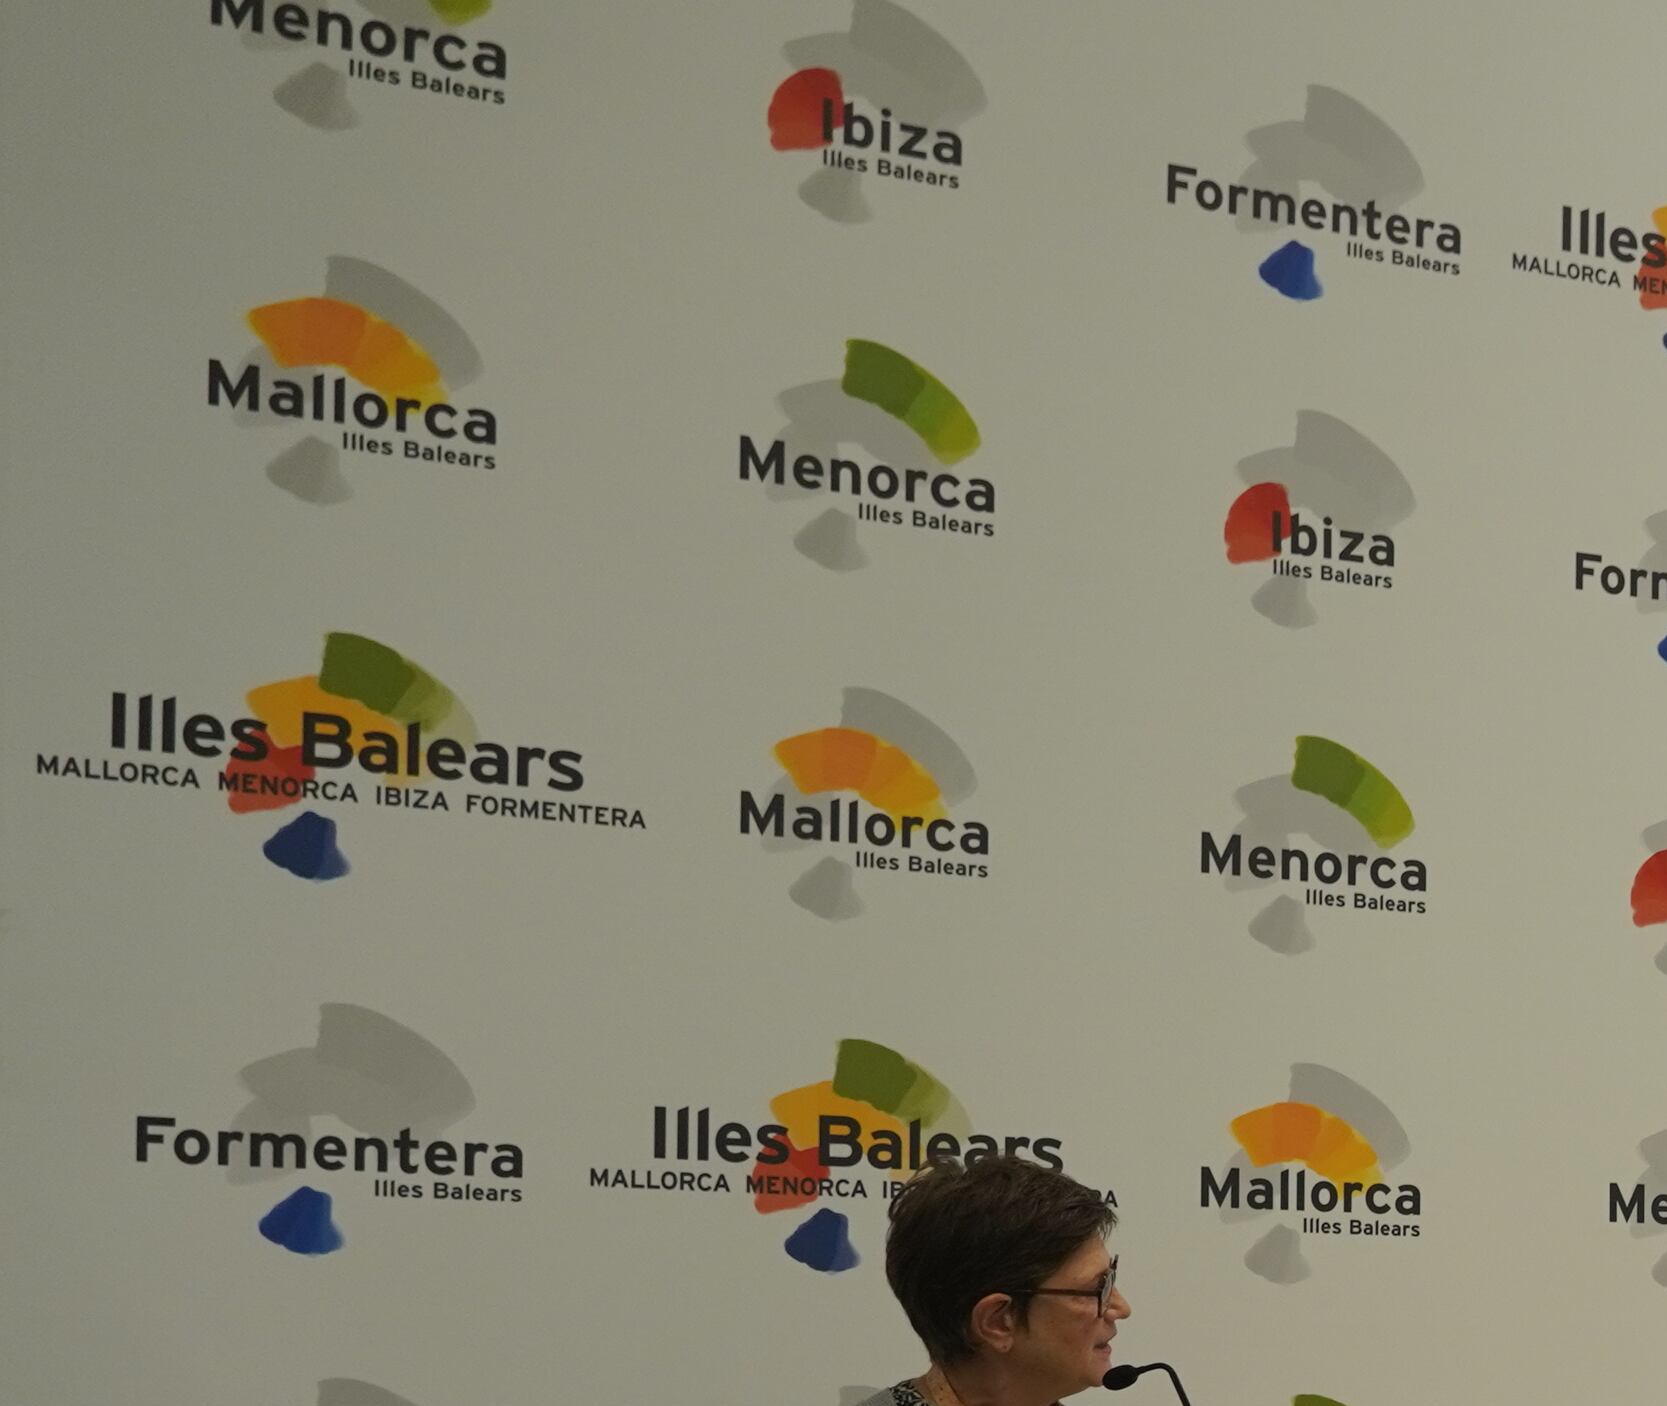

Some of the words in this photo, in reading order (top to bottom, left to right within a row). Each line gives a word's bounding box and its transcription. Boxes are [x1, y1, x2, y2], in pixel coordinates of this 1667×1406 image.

[210, 0, 507, 81] Menorca
[349, 58, 401, 86] Illes
[411, 70, 505, 105] Balears
[821, 96, 963, 167] Ibiza
[823, 148, 868, 173] Illes
[877, 158, 959, 189] Balears
[1166, 163, 1462, 255] Formentera
[1347, 241, 1385, 262] Illes
[1391, 249, 1460, 276] Balears
[1561, 205, 1667, 269] Illes
[1512, 252, 1621, 288] MALLORCA
[207, 358, 497, 446] Mallorca
[342, 431, 394, 456] Illes
[403, 440, 496, 470] Balears
[739, 434, 995, 514] Menorca
[858, 502, 903, 525] Illes
[912, 509, 995, 537] Balears
[1271, 510, 1395, 568] Ibiza
[1273, 559, 1313, 579] Illes
[1320, 564, 1393, 589] Balears
[111, 691, 270, 763] Illes
[300, 711, 584, 793] Balears
[36, 753, 201, 789] MALLORCA
[217, 771, 359, 804] MENORCA
[376, 785, 449, 812] IBIZA
[466, 793, 646, 830] FORMENTERA
[739, 790, 989, 856] Mallorca
[855, 850, 900, 871] Illes
[908, 855, 989, 879] Balears
[1200, 831, 1427, 893] Menorca
[1306, 888, 1346, 908] Illes
[1353, 892, 1427, 914] Balears
[135, 1115, 523, 1179] Formentera
[653, 1105, 791, 1166] Illes
[374, 1179, 424, 1199] Illes
[433, 1181, 523, 1203] Balears
[589, 1167, 731, 1193] MALLORCA
[745, 1174, 868, 1199] MENORCA
[1200, 1165, 1421, 1216] Mallorca
[1303, 1217, 1342, 1235] Illes
[1349, 1219, 1421, 1238] Balears
